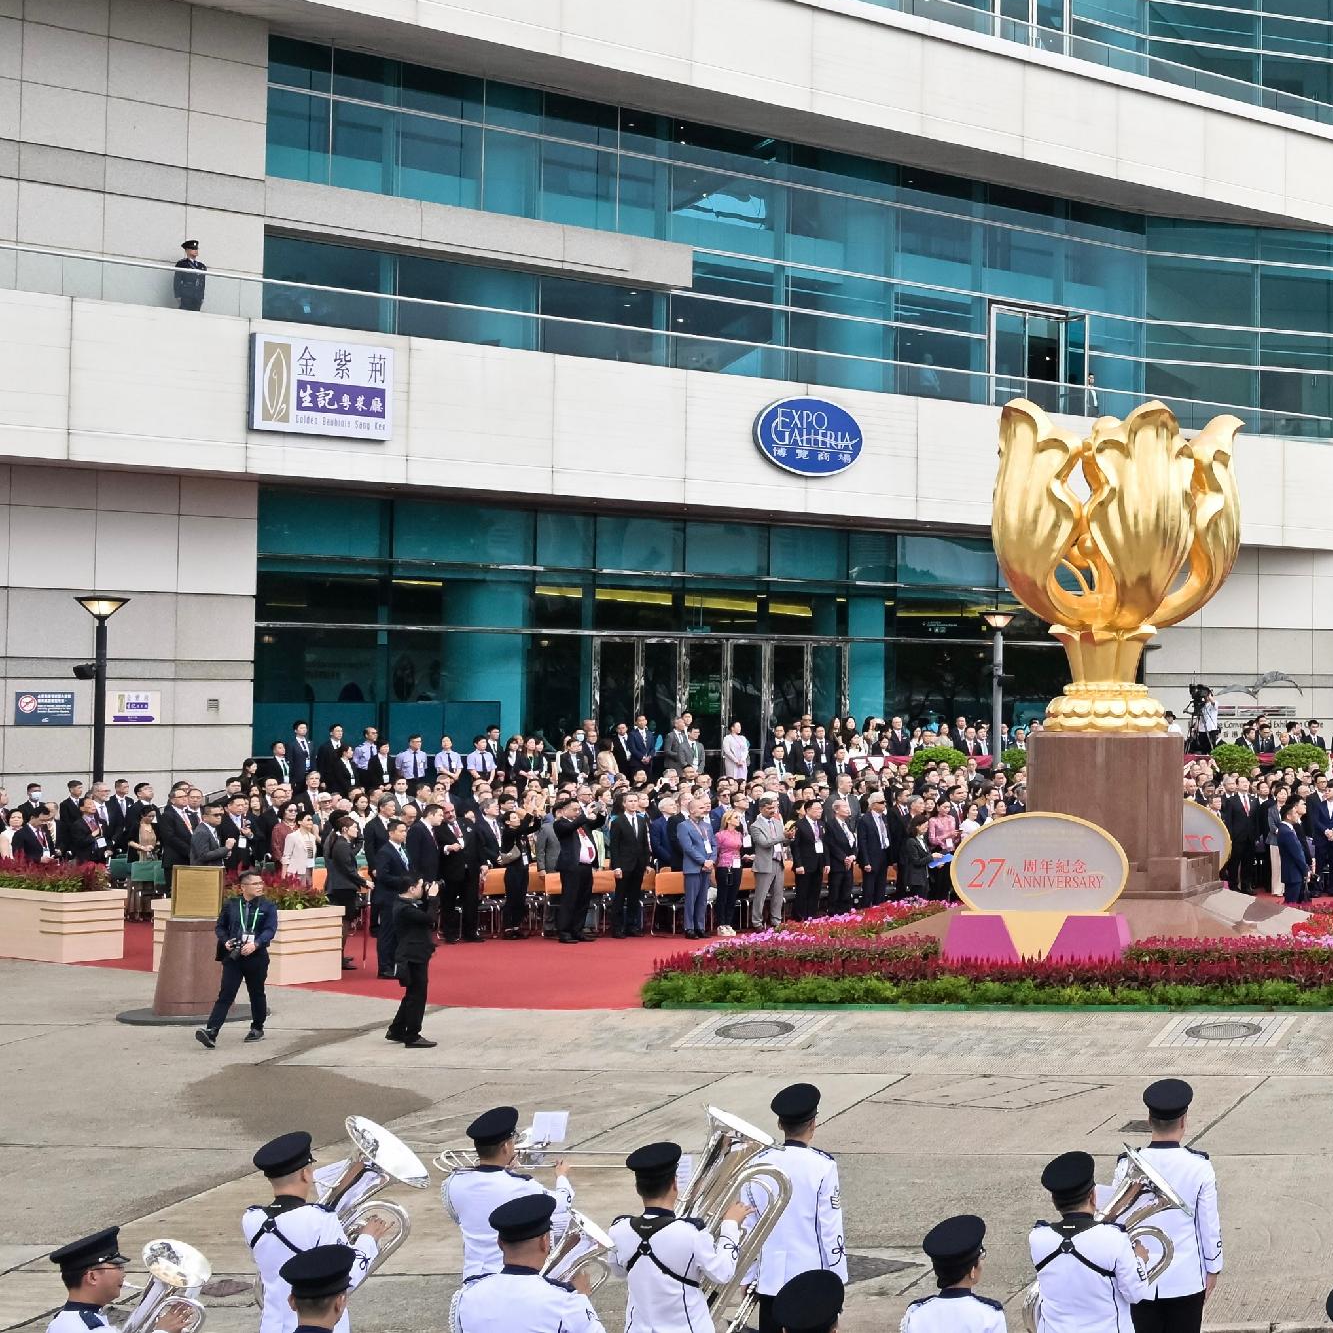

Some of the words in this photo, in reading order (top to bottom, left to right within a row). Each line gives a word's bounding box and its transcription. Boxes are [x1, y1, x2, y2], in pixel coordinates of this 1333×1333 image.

[777, 408, 828, 430] EXPO
[771, 418, 853, 450] GALLERIA
[1023, 859, 1087, 875] 周年紀念
[1012, 873, 1104, 889] ANNIVERSARY
